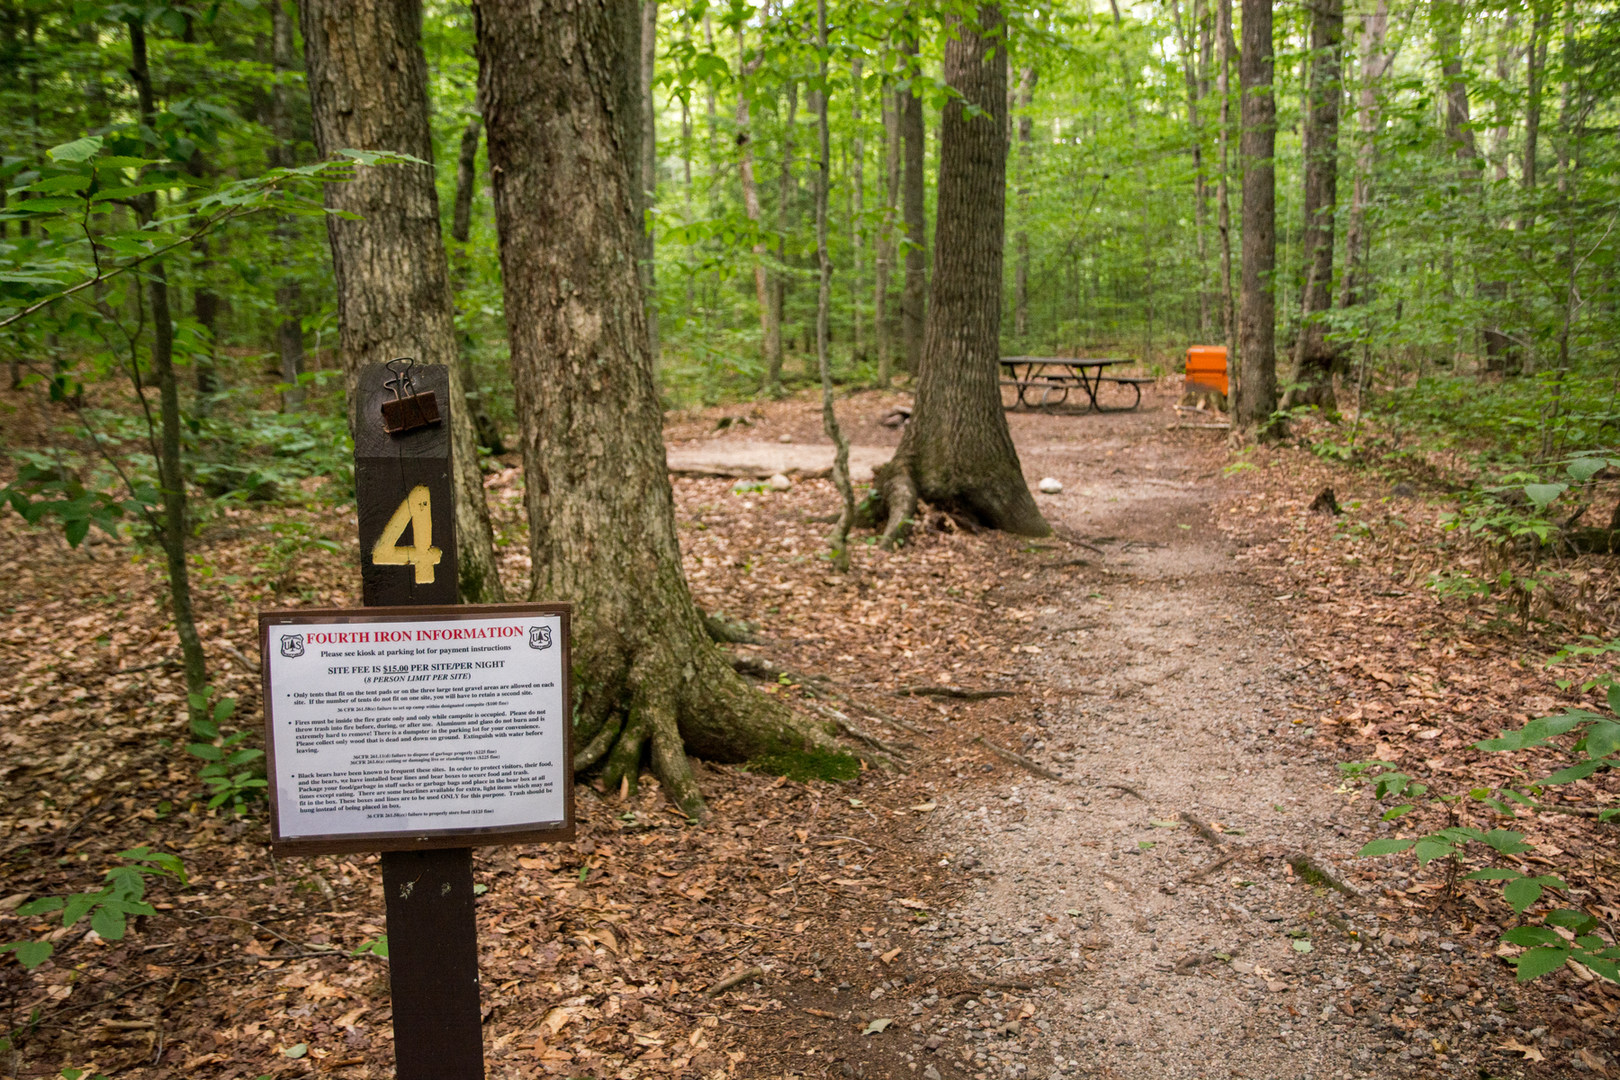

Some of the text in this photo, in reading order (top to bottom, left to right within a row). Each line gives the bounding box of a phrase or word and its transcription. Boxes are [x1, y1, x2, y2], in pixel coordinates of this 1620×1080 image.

[372, 485, 443, 584] 4
[306, 626, 524, 644] FOURTH IRON INFORMATION
[386, 648, 414, 656] parking
[438, 646, 469, 654] payment
[382, 664, 409, 672] $15.00
